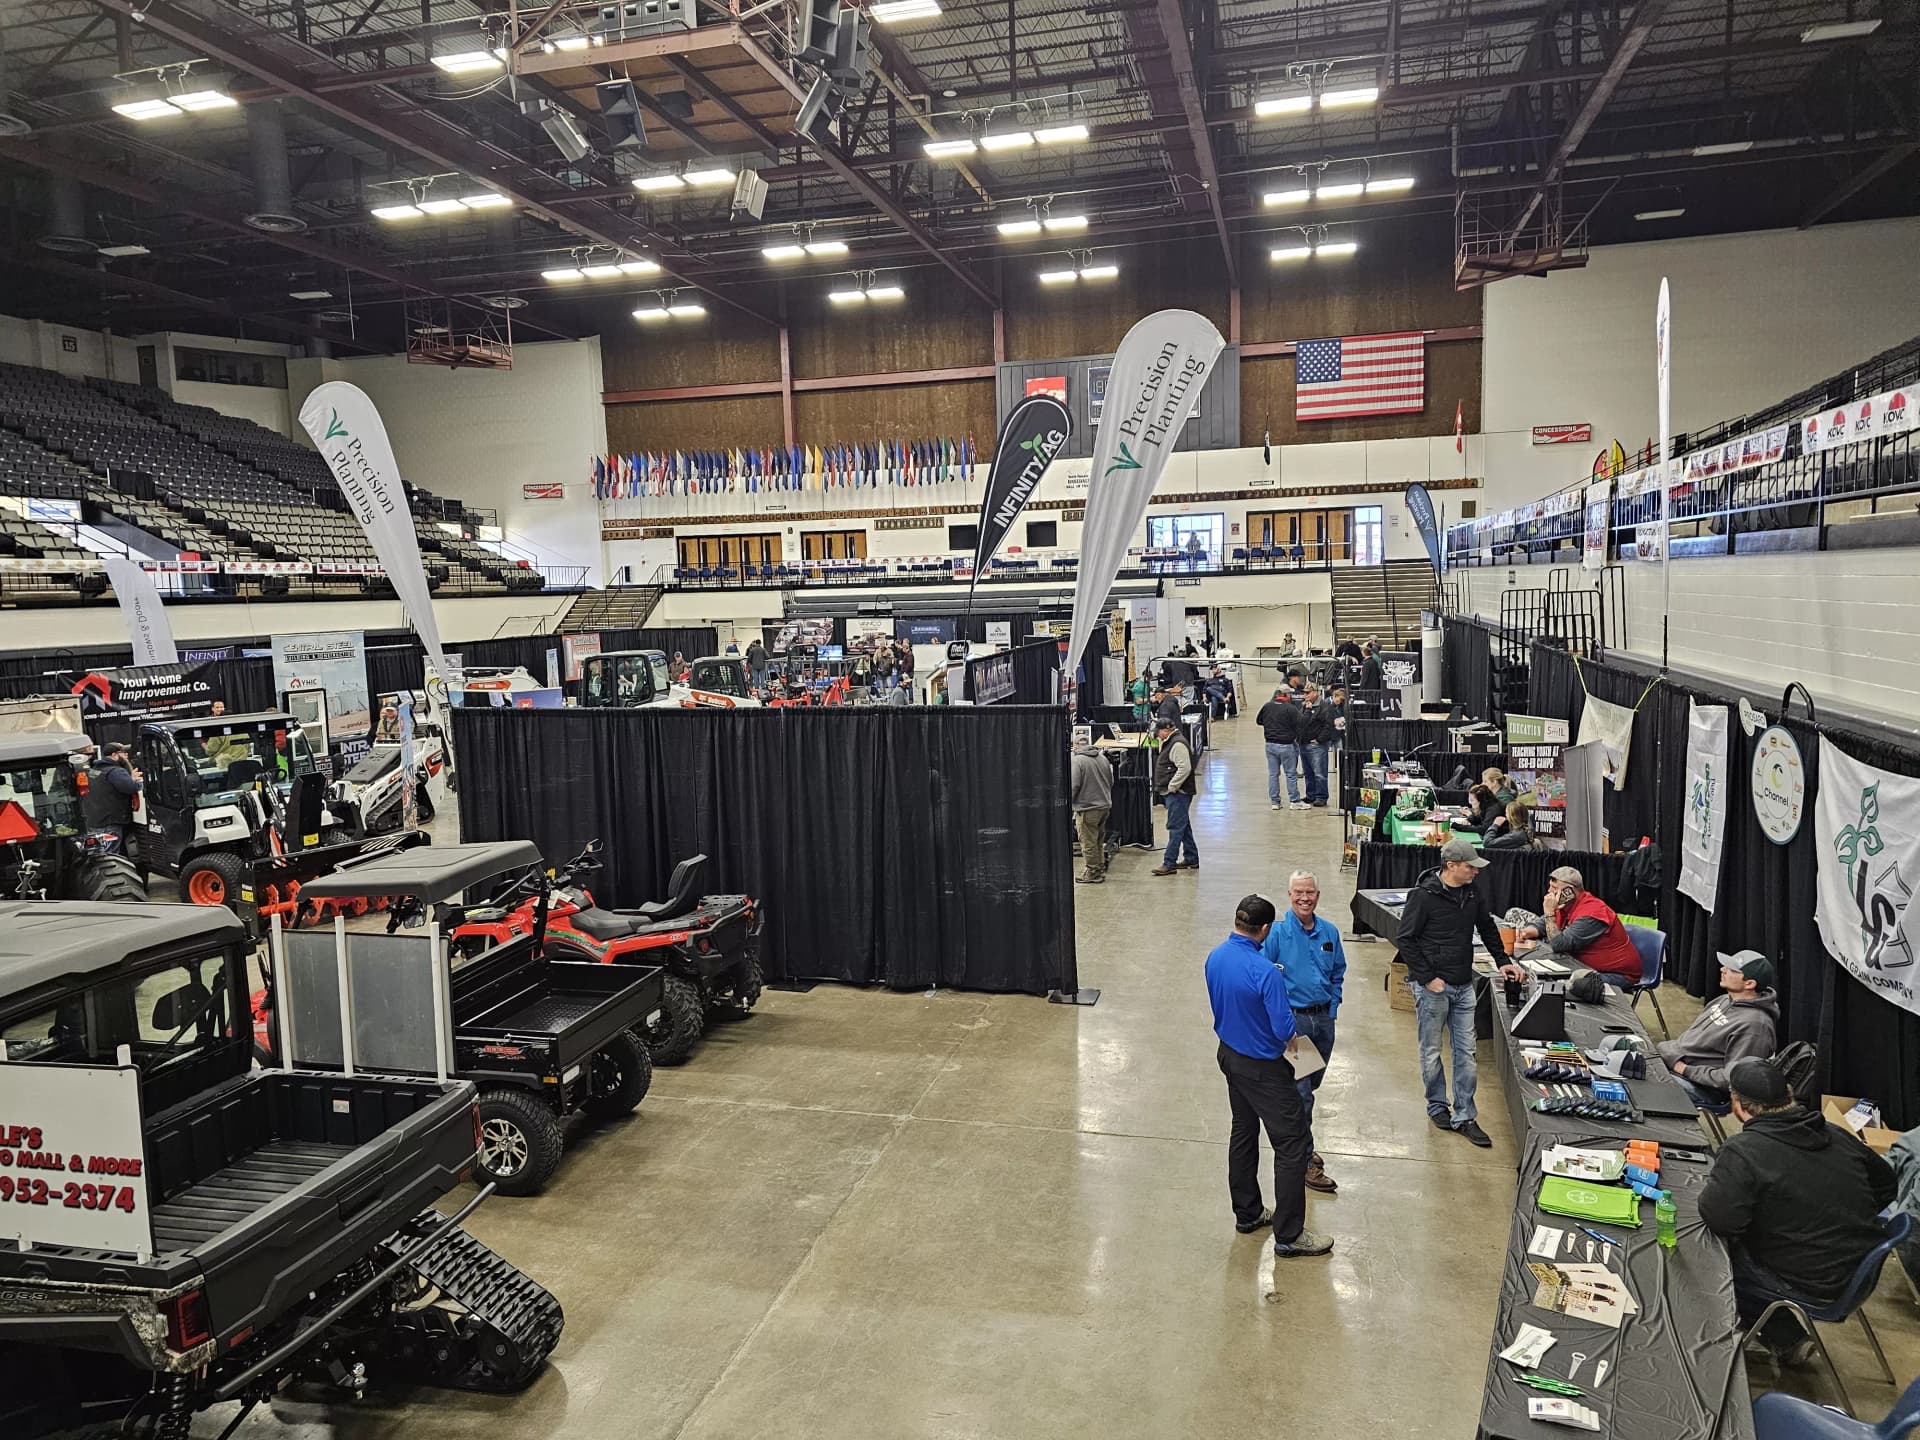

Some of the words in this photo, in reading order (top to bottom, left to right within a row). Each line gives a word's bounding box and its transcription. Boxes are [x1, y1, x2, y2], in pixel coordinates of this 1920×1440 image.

[64, 341, 75, 351] 15
[1119, 342, 1179, 439] Precision
[1143, 355, 1206, 448] Planting
[1855, 417, 1871, 432] KOVC
[1883, 409, 1905, 425] KOVC
[1534, 426, 1577, 434] CONCESSIONS
[1828, 425, 1845, 438] KOVC
[348, 438, 395, 515] Precision
[993, 455, 1044, 529] INFINITY
[1041, 429, 1065, 458] AG
[332, 451, 376, 525] Planting
[327, 640, 355, 650] STEEL
[184, 650, 229, 662] INFINITY
[119, 677, 147, 688] Your
[149, 674, 182, 685] Home
[301, 678, 317, 686] YHIC
[118, 683, 191, 701] Improvement
[193, 681, 211, 692] Co.
[1510, 722, 1542, 737] EDUCATION
[1512, 747, 1536, 757] TEACHING
[1537, 746, 1551, 757] YOUTH
[1553, 746, 1559, 757] AT
[1537, 758, 1554, 769] CAMPS
[1764, 787, 1788, 806] Channel
[1872, 976, 1914, 1000] COMPNY
[16, 1150, 65, 1171] MALL
[68, 1154, 84, 1173] &
[87, 1155, 142, 1177] MORE
[0, 1175, 136, 1214] 952-2374
